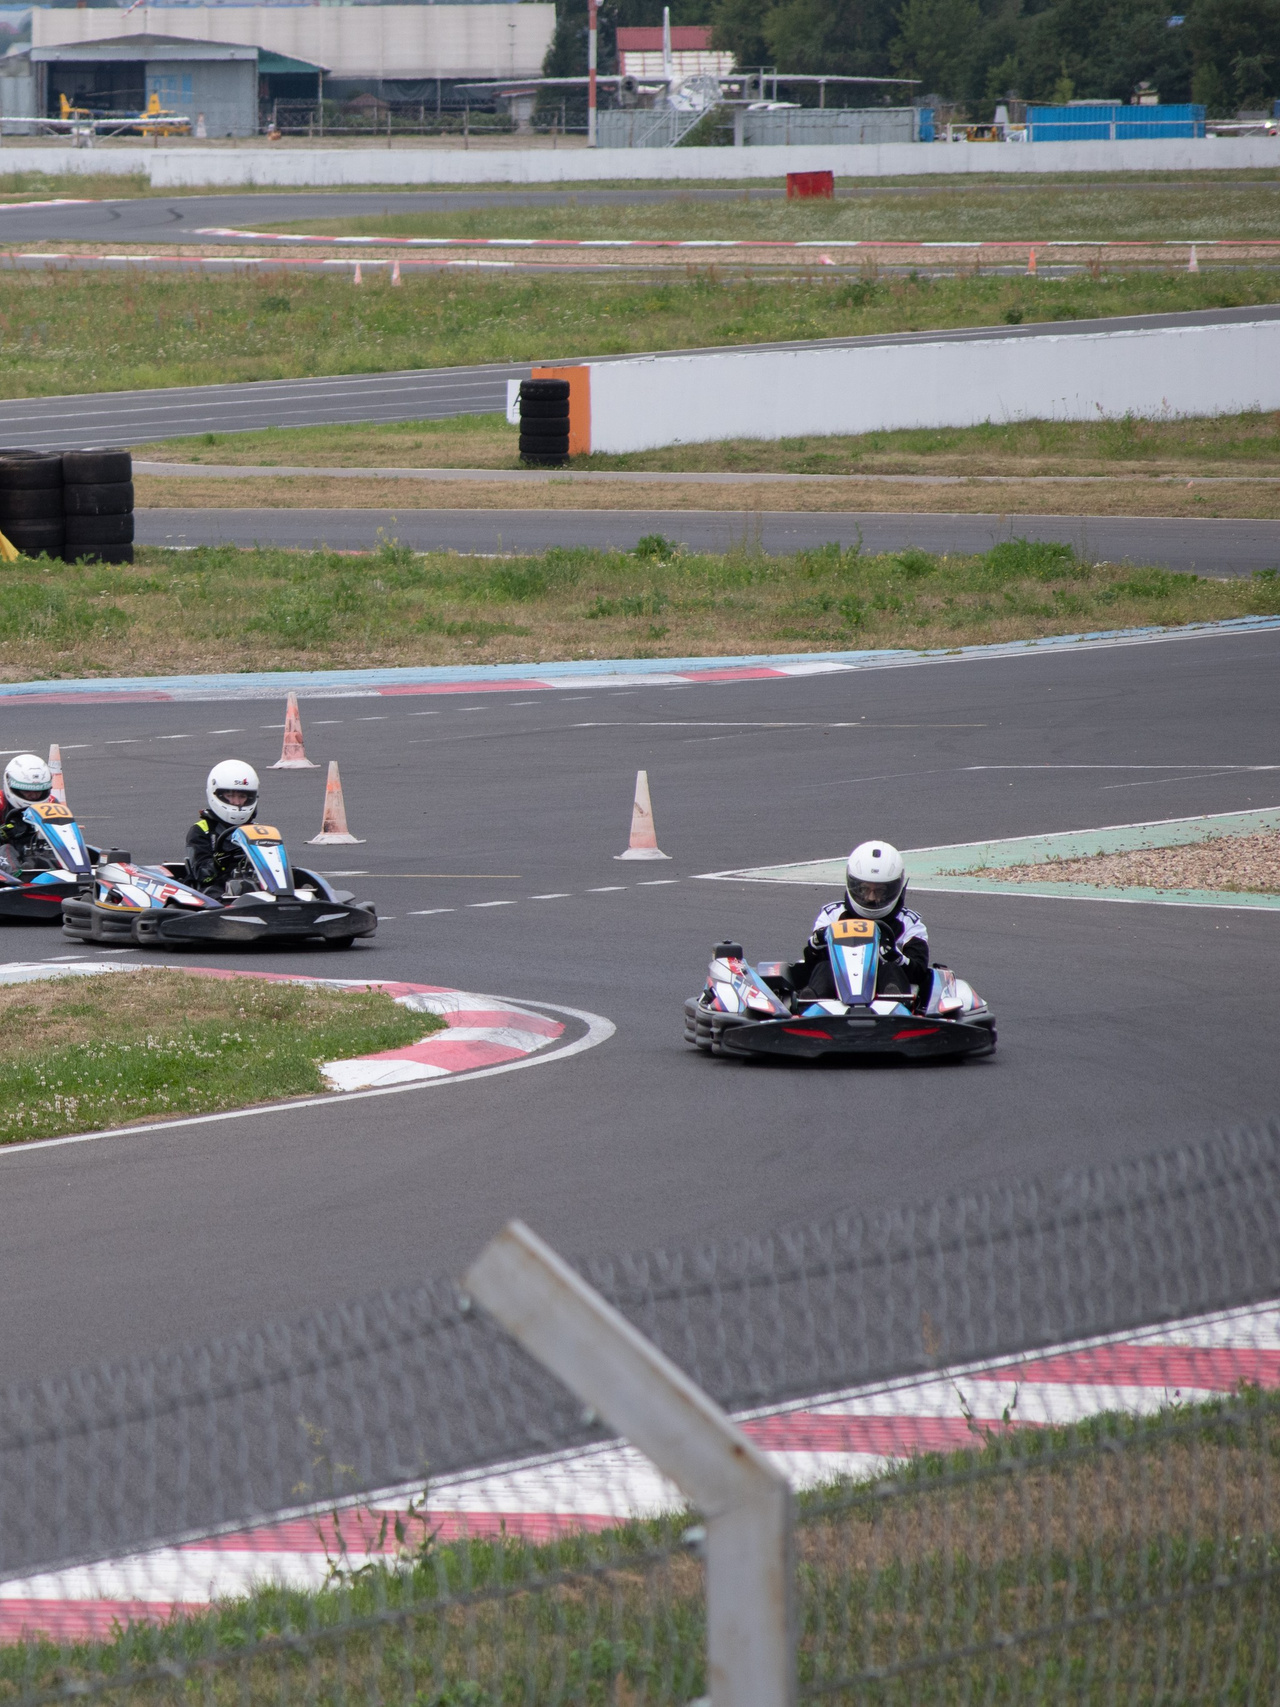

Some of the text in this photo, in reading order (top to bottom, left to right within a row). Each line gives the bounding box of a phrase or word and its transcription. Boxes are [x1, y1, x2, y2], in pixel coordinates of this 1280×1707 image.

[40, 805, 69, 817] 20
[254, 825, 269, 835] 6
[839, 921, 868, 934] 13
